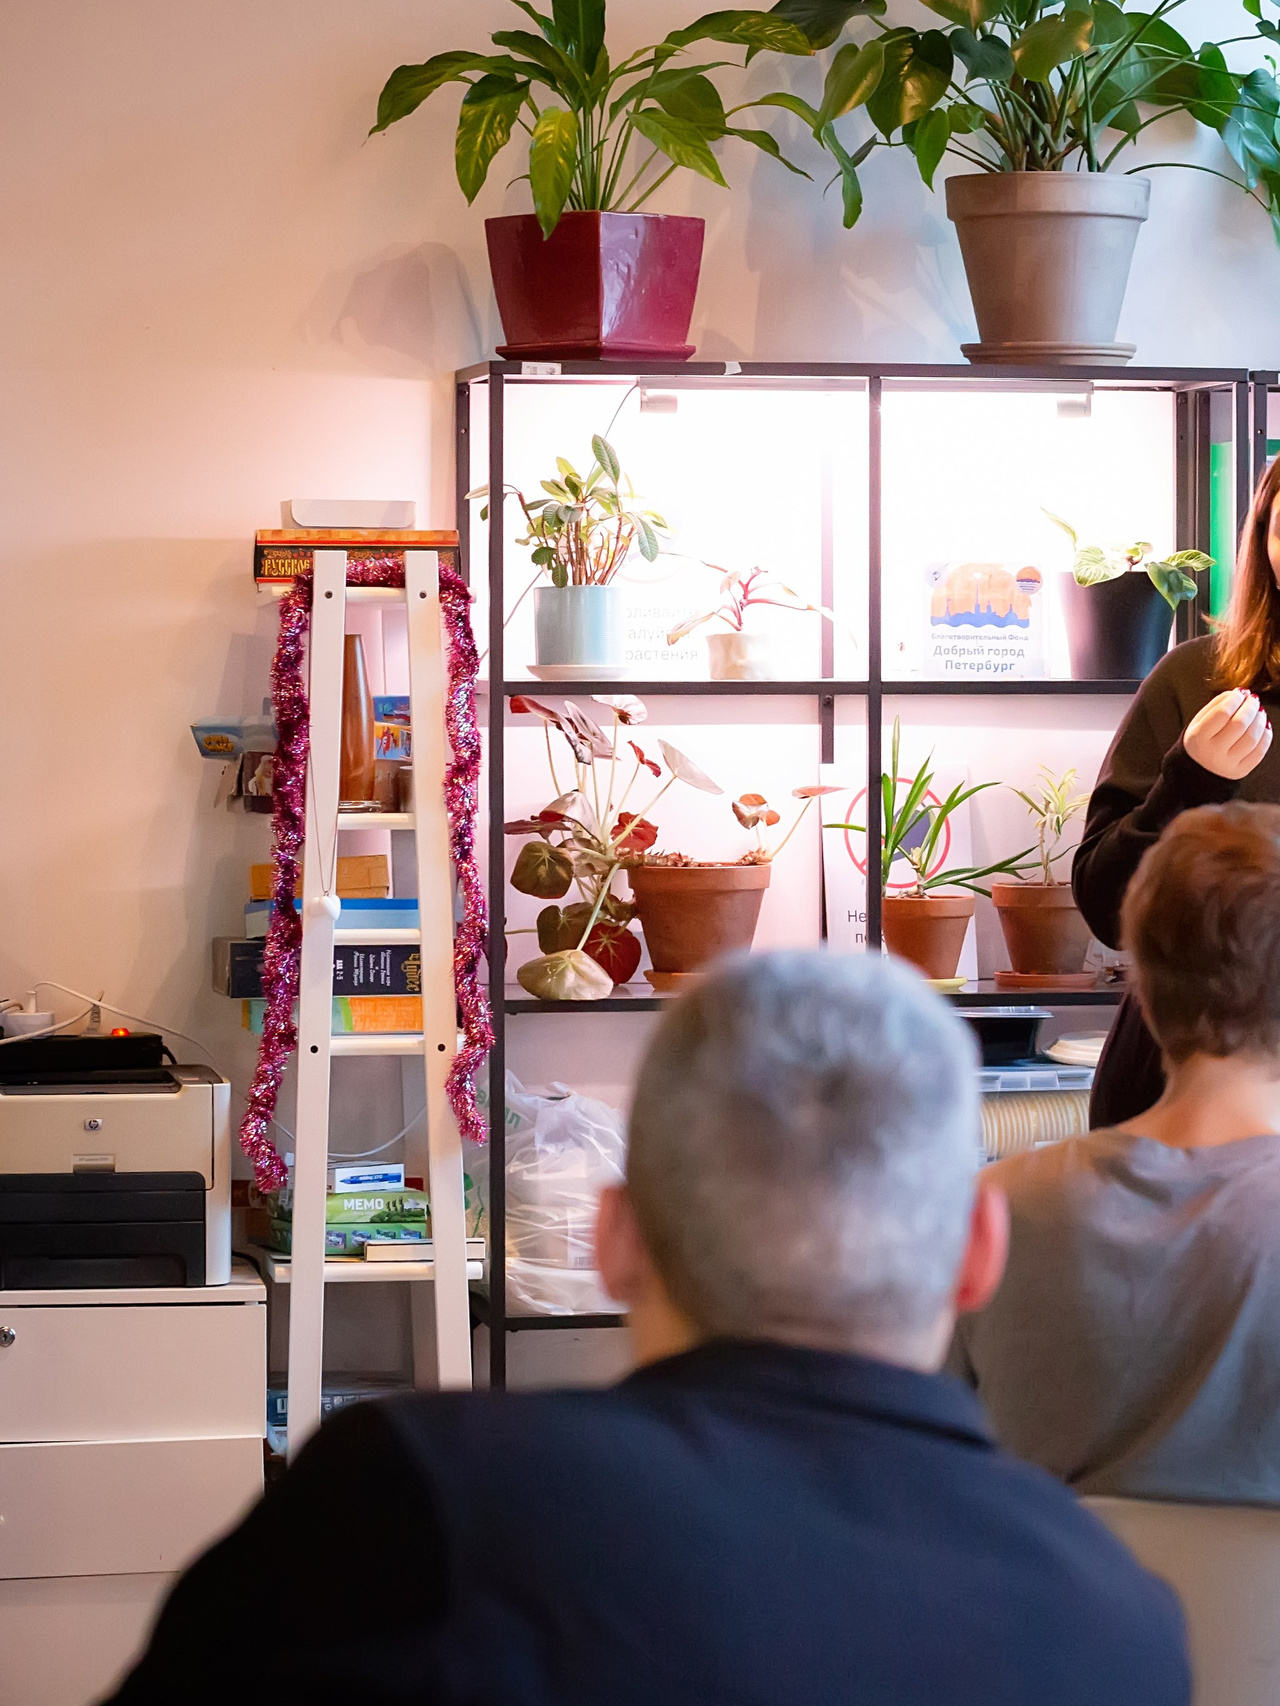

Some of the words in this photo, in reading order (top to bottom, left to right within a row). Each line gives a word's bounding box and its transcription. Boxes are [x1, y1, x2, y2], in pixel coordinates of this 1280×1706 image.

[931, 632, 1007, 641] Благотворительный
[1007, 633, 1029, 641] Фонд
[625, 650, 698, 663] растения
[933, 645, 985, 657] Добрый
[987, 646, 1025, 658] город
[945, 659, 1015, 672] Петербург
